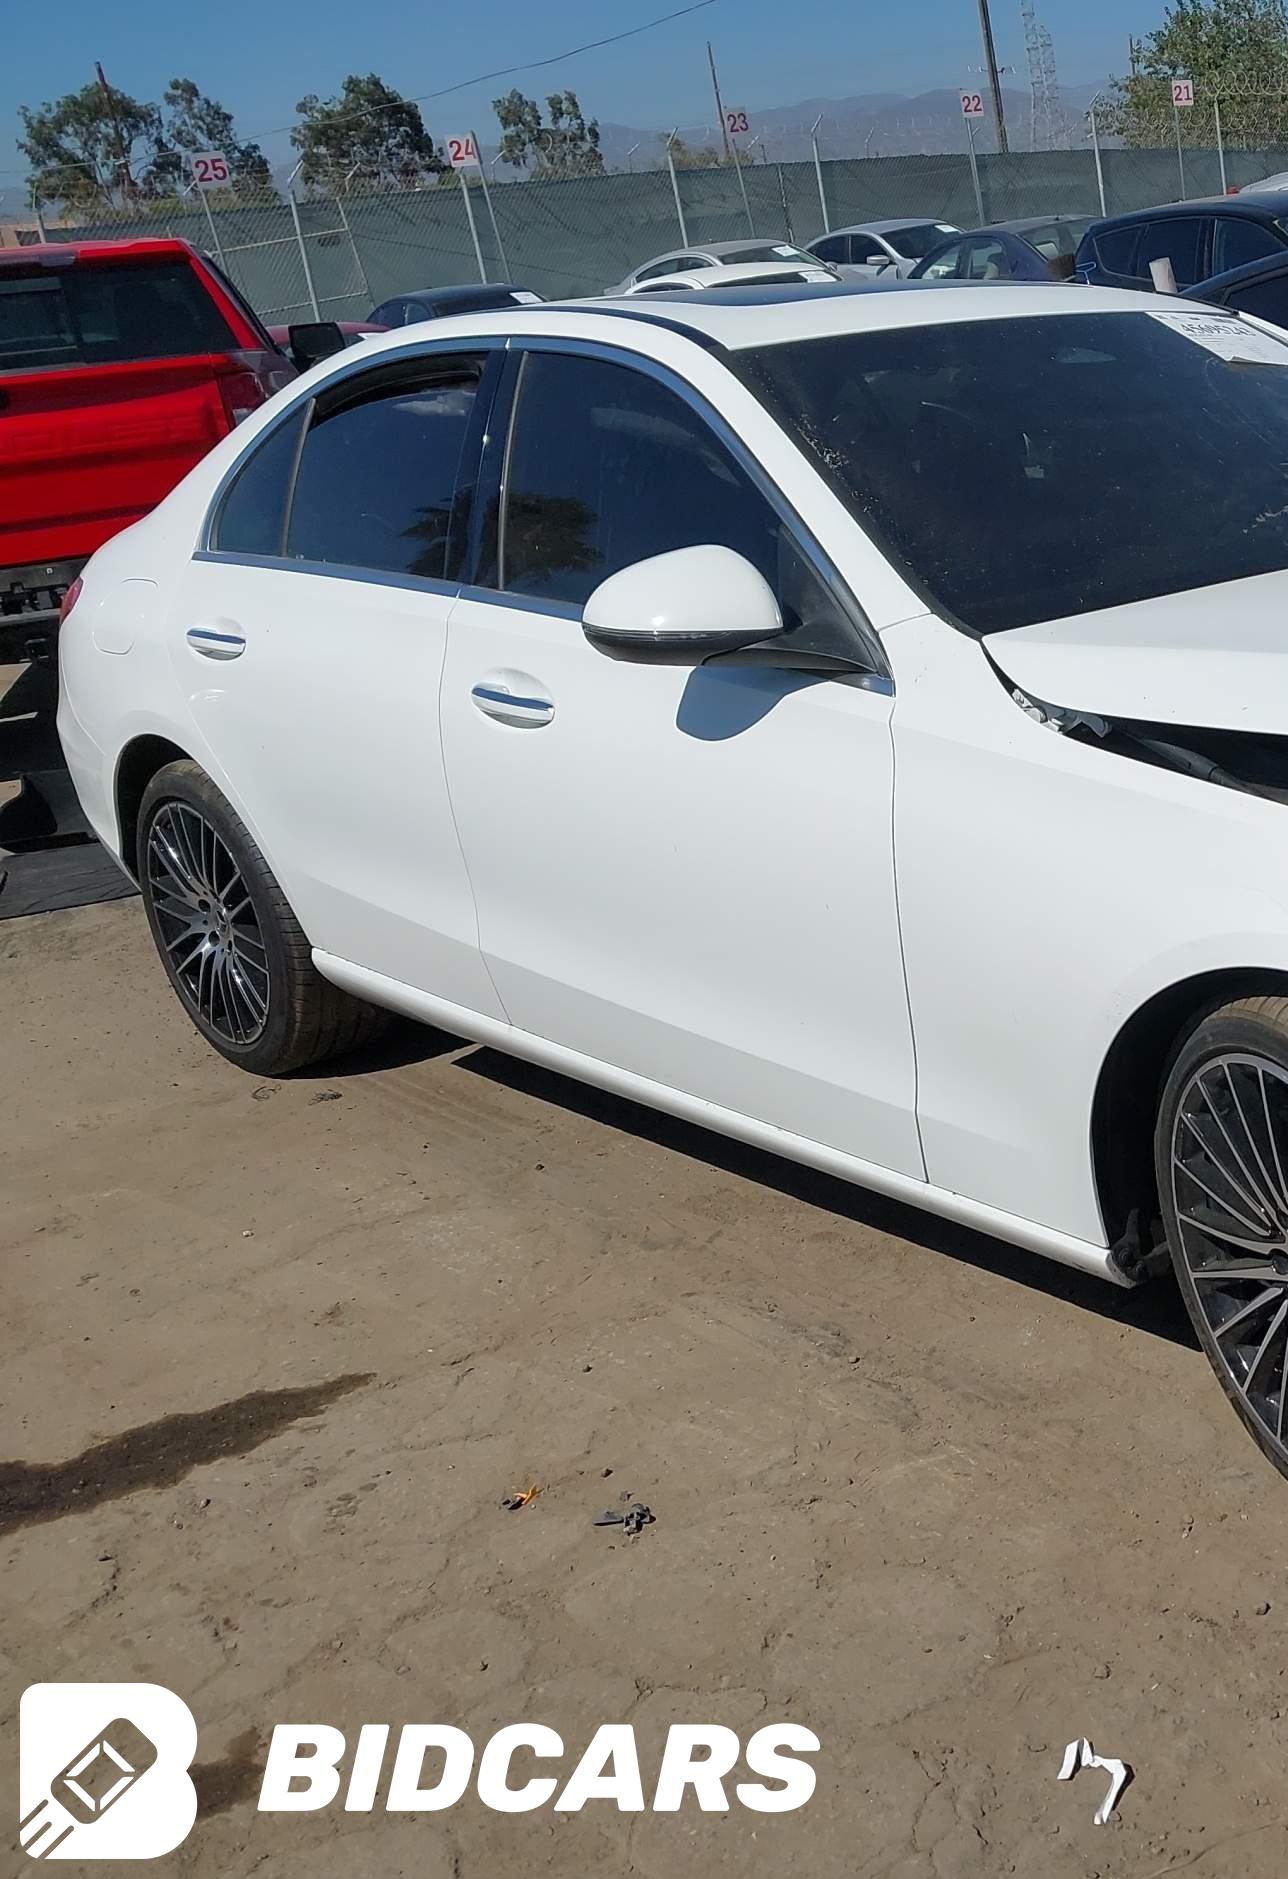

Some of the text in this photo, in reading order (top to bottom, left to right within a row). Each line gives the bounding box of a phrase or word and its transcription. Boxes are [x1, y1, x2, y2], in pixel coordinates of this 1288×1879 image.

[1174, 85, 1192, 101] 21
[962, 94, 983, 113] 22
[727, 112, 749, 132] 23
[448, 138, 477, 161] 24
[194, 158, 228, 182] 25
